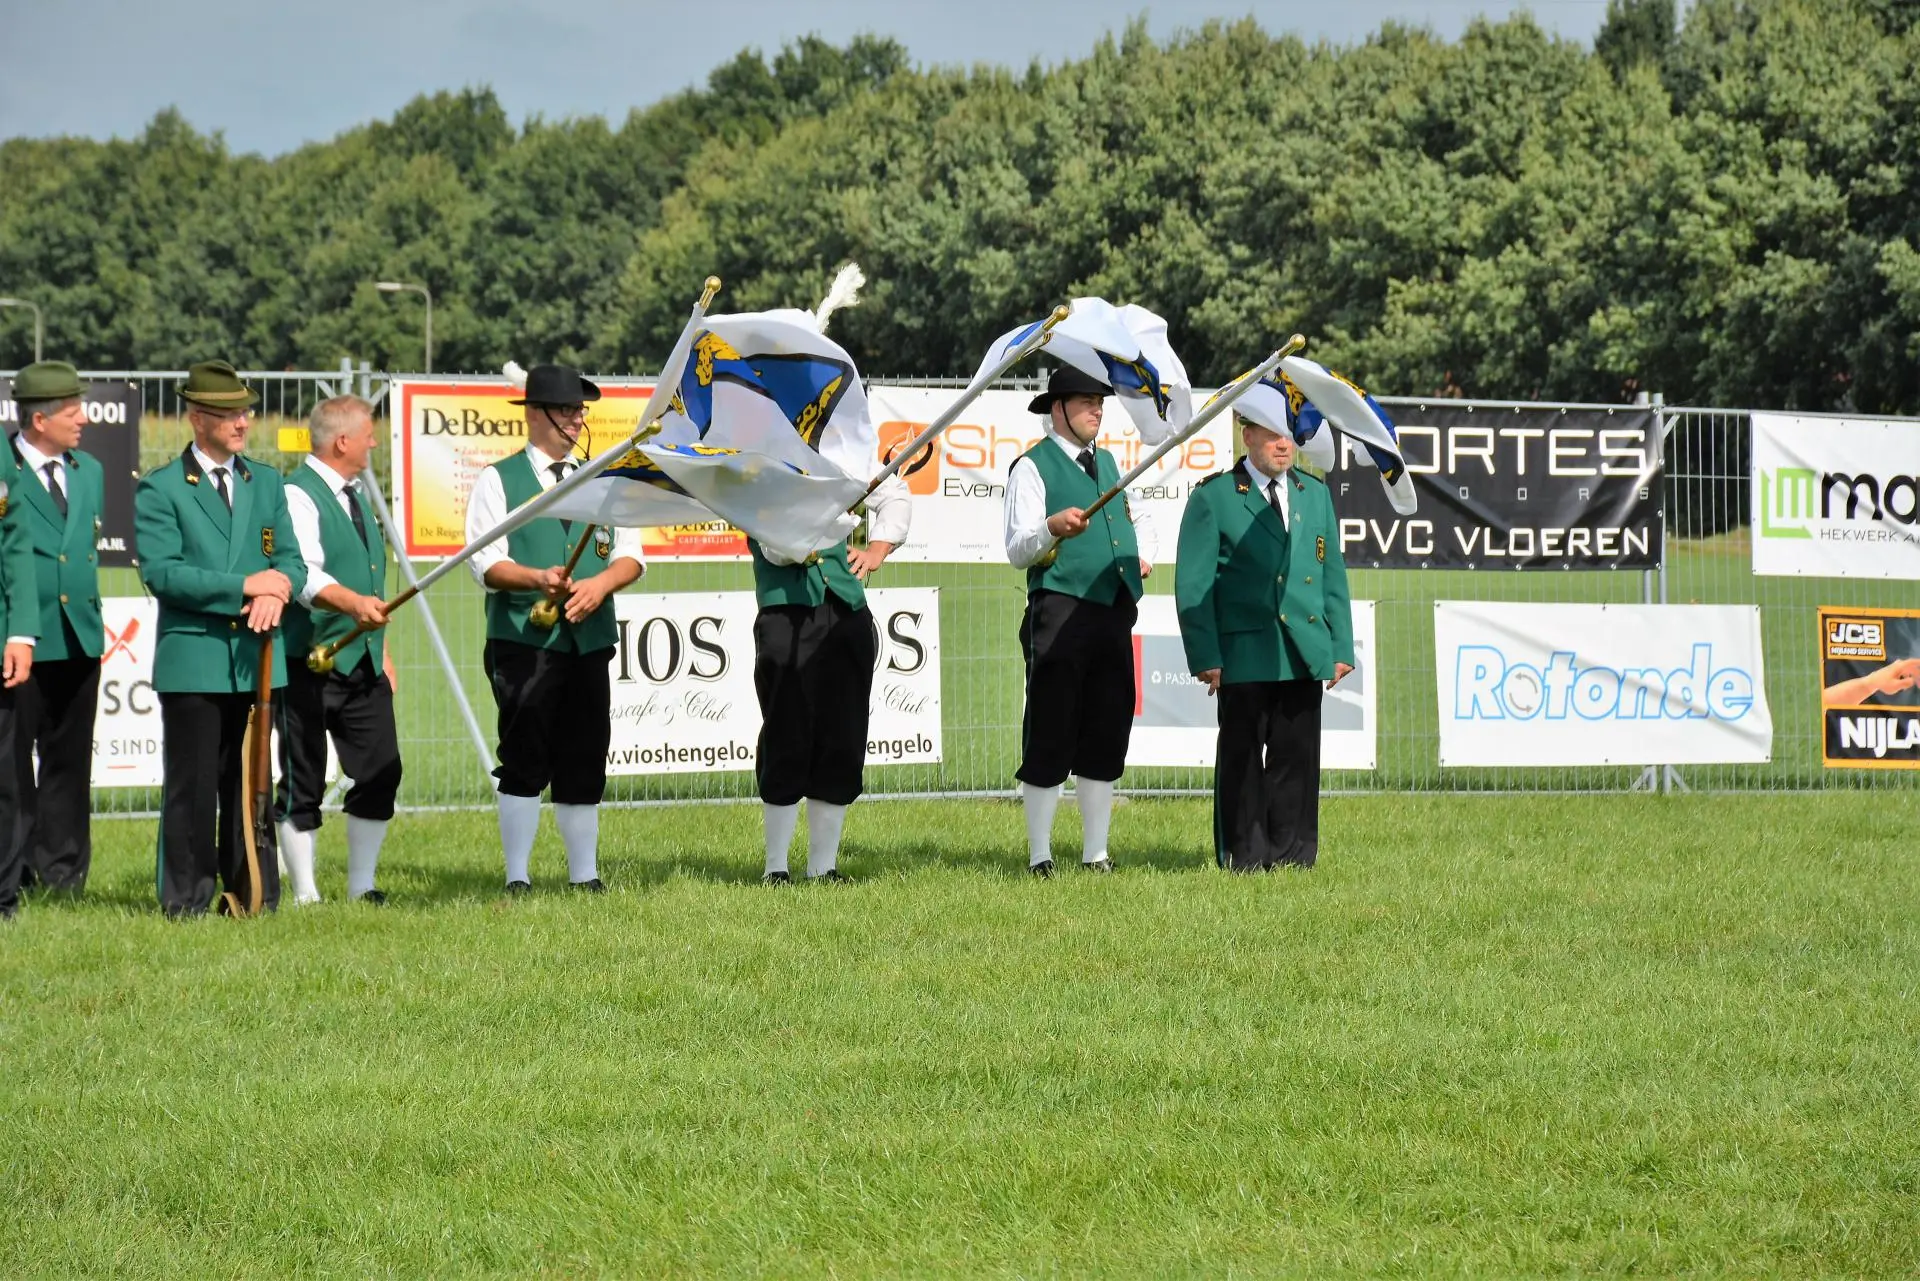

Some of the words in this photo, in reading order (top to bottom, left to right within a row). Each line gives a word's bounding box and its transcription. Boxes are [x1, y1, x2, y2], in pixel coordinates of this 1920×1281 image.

[1339, 518, 1434, 555] PVC
[1454, 526, 1649, 557] VLOEREN
[1820, 528, 1898, 543] HEKWERK
[1830, 623, 1881, 645] JCB
[1455, 643, 1754, 721] Rotonde
